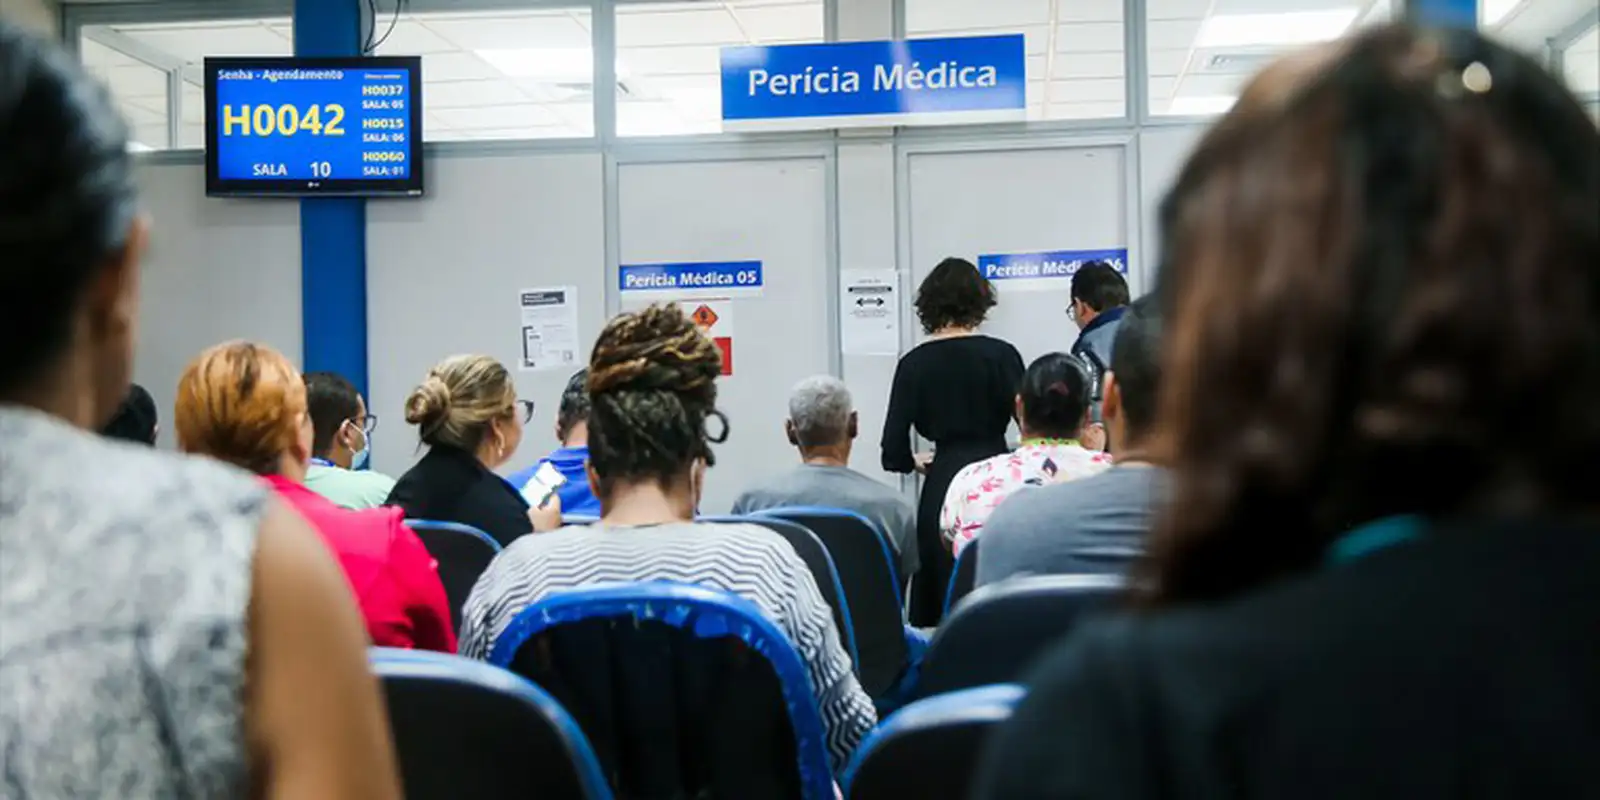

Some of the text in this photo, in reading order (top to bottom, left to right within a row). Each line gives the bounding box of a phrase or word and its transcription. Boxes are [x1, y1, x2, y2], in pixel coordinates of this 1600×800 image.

[218, 69, 254, 81] Senha
[262, 69, 344, 83] Agendamento
[747, 61, 997, 96] Perícia Médica
[362, 85, 404, 97] H0037
[362, 100, 390, 110] SALA:
[223, 104, 346, 136] H0042
[362, 118, 404, 129] H0015
[362, 133, 390, 143] SALA:
[253, 162, 332, 177] SALA 10
[363, 166, 390, 177] SALA:
[985, 263, 1039, 278] Perícia
[625, 270, 757, 287] Perícia Médica 05
